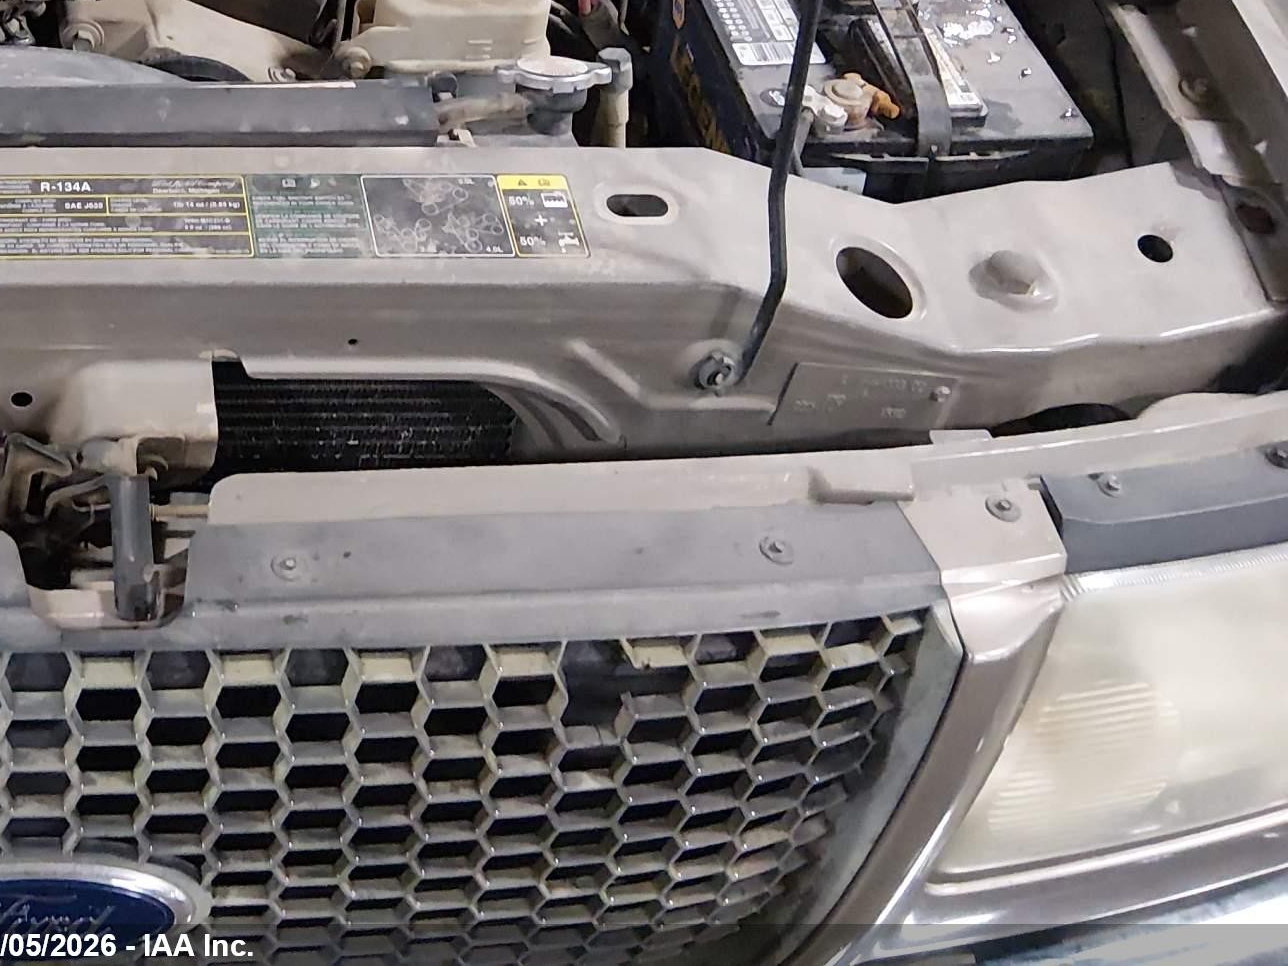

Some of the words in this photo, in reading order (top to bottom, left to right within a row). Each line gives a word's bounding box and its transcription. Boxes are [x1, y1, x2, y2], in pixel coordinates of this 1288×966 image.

[40, 181, 92, 192] R-134A
[508, 196, 535, 206] 50%
[520, 236, 546, 246] 50%
